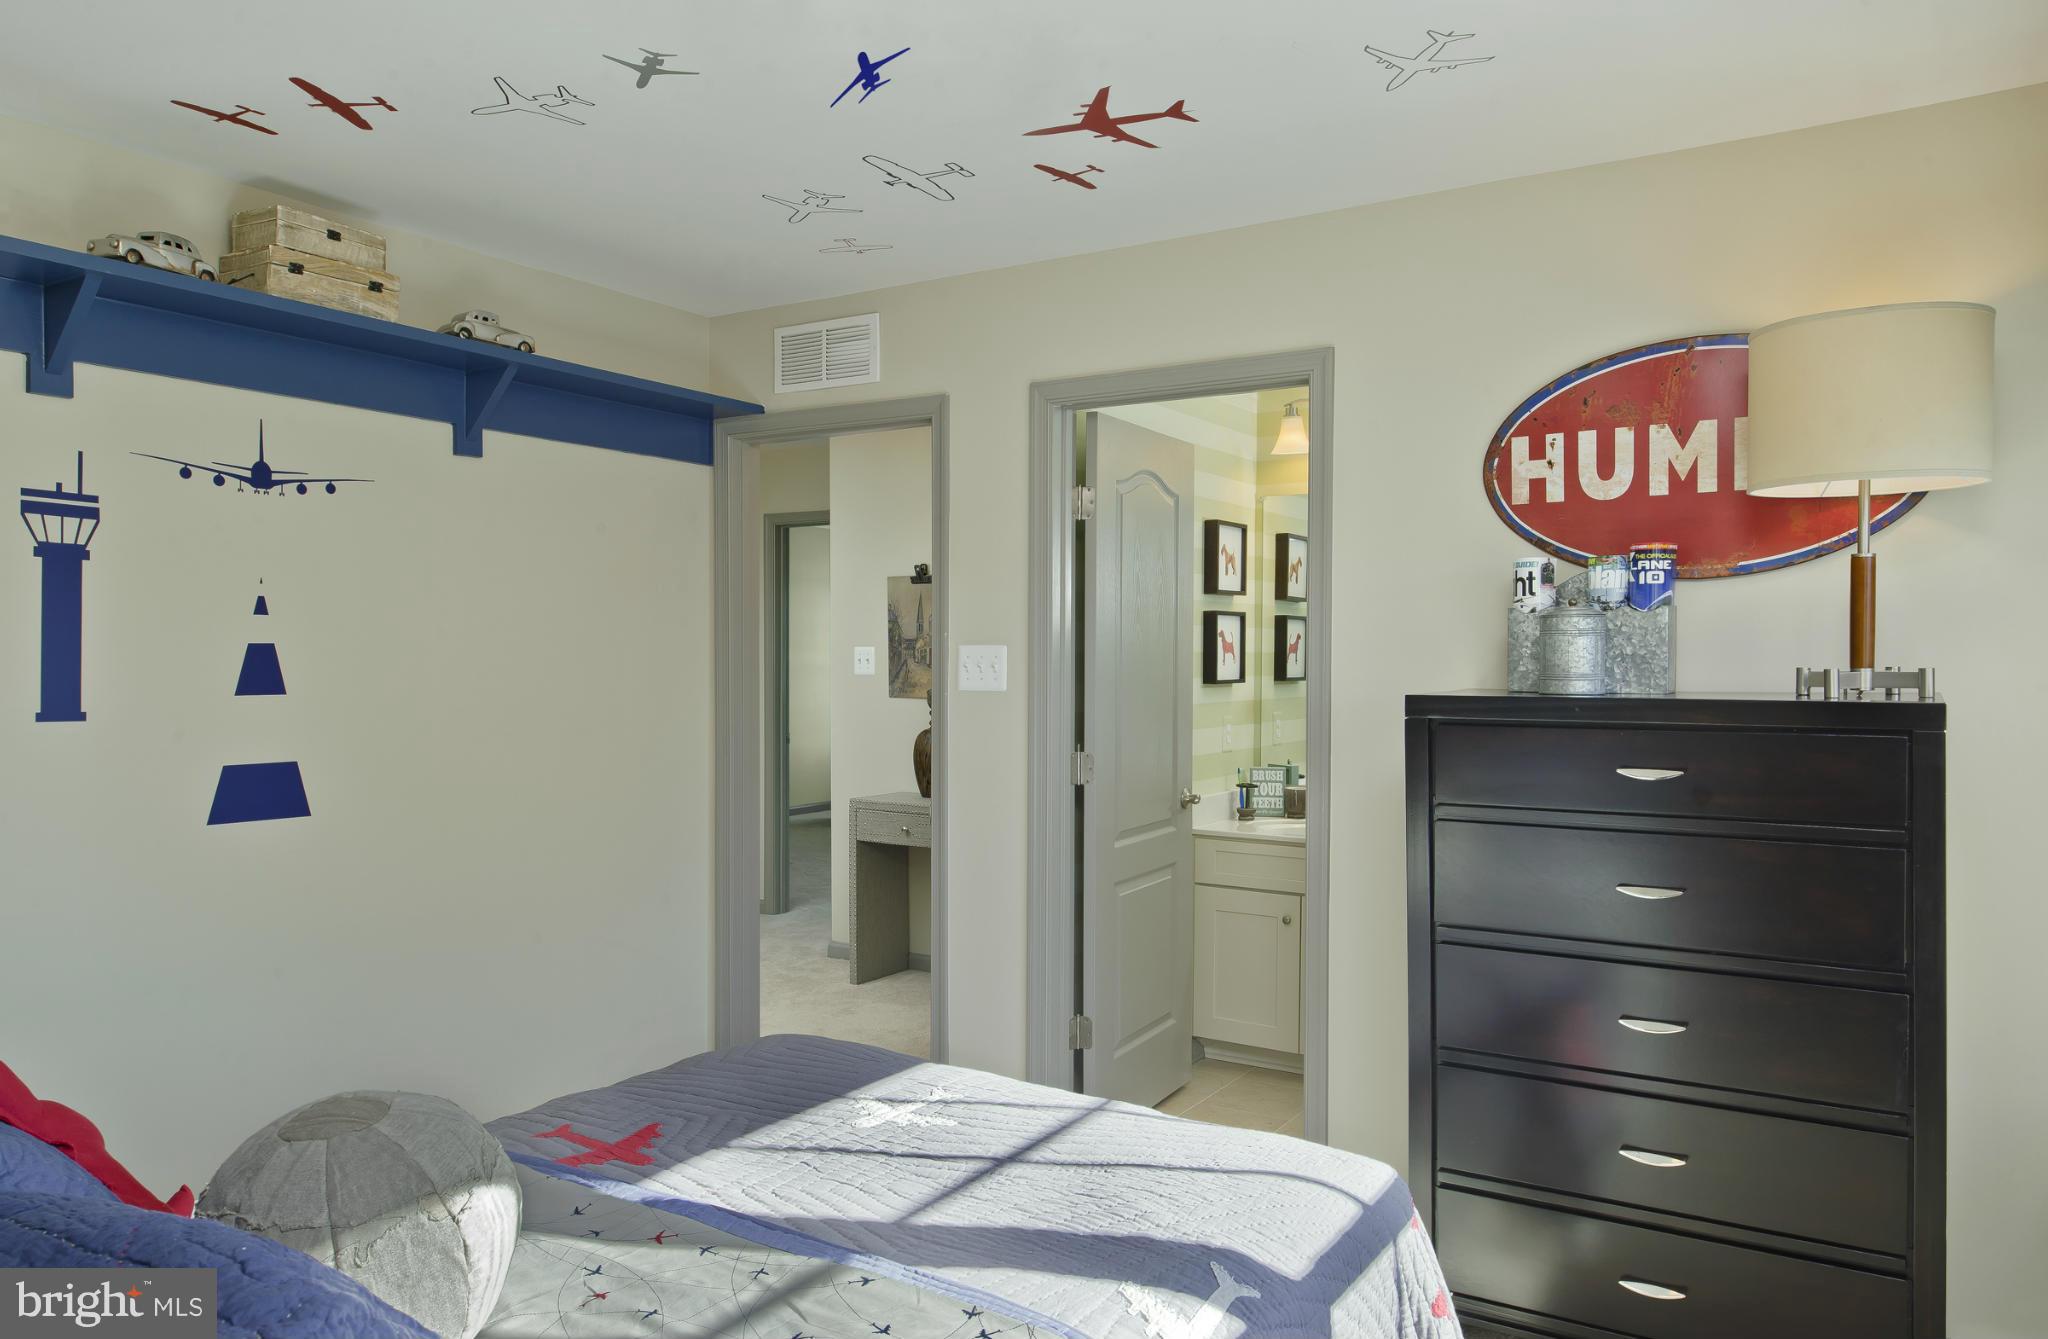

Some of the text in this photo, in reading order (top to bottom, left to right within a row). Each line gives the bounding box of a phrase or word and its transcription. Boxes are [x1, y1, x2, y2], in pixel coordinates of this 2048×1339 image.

[1638, 570, 1665, 584] 10
[1252, 770, 1283, 781] BRUSH
[1252, 797, 1283, 808] TEETH
